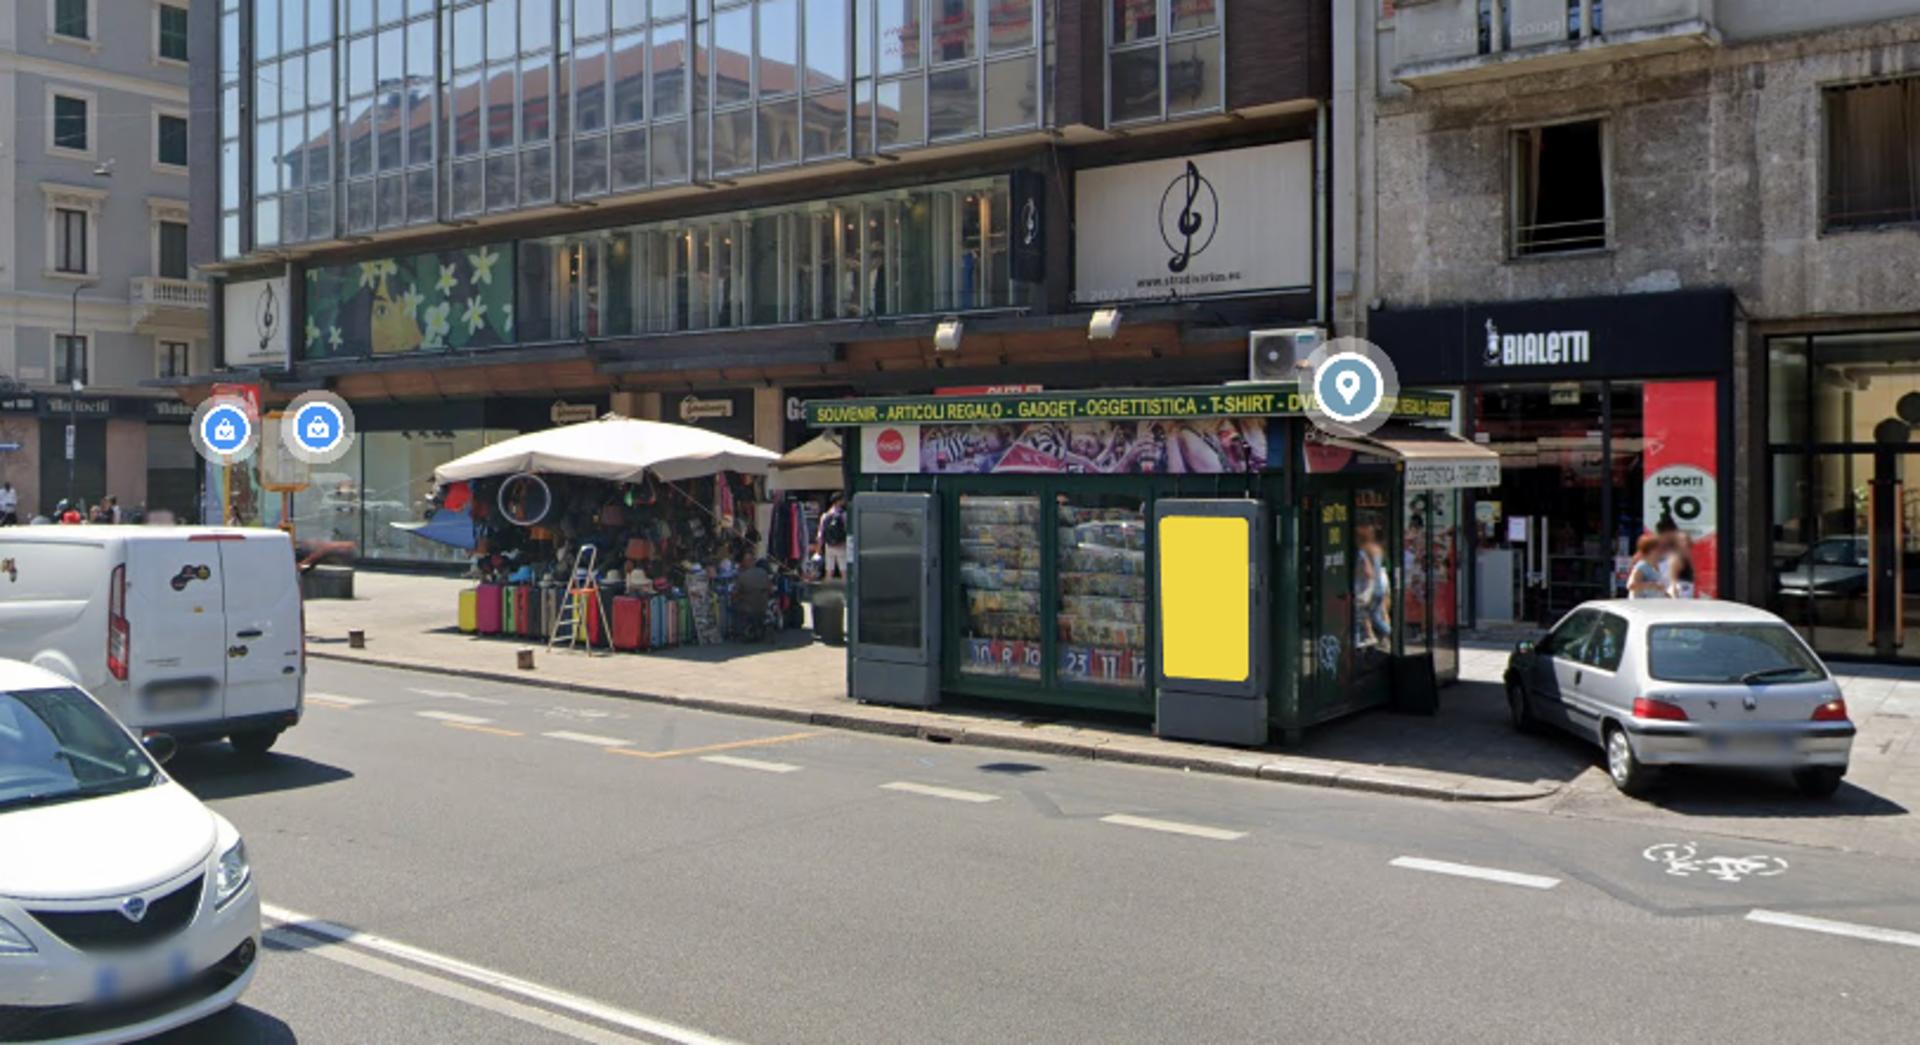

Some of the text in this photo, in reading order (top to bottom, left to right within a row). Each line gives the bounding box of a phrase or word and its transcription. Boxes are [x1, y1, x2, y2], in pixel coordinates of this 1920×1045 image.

[1503, 331, 1590, 365] BIALETTI
[818, 406, 878, 422] SOUVENIR
[887, 403, 944, 420] ARTICOLI
[947, 402, 1002, 419] REGALO
[1019, 401, 1076, 417] GADGET
[1087, 398, 1197, 416] OGGETTISTICA
[1210, 395, 1274, 413] T-SHIRT
